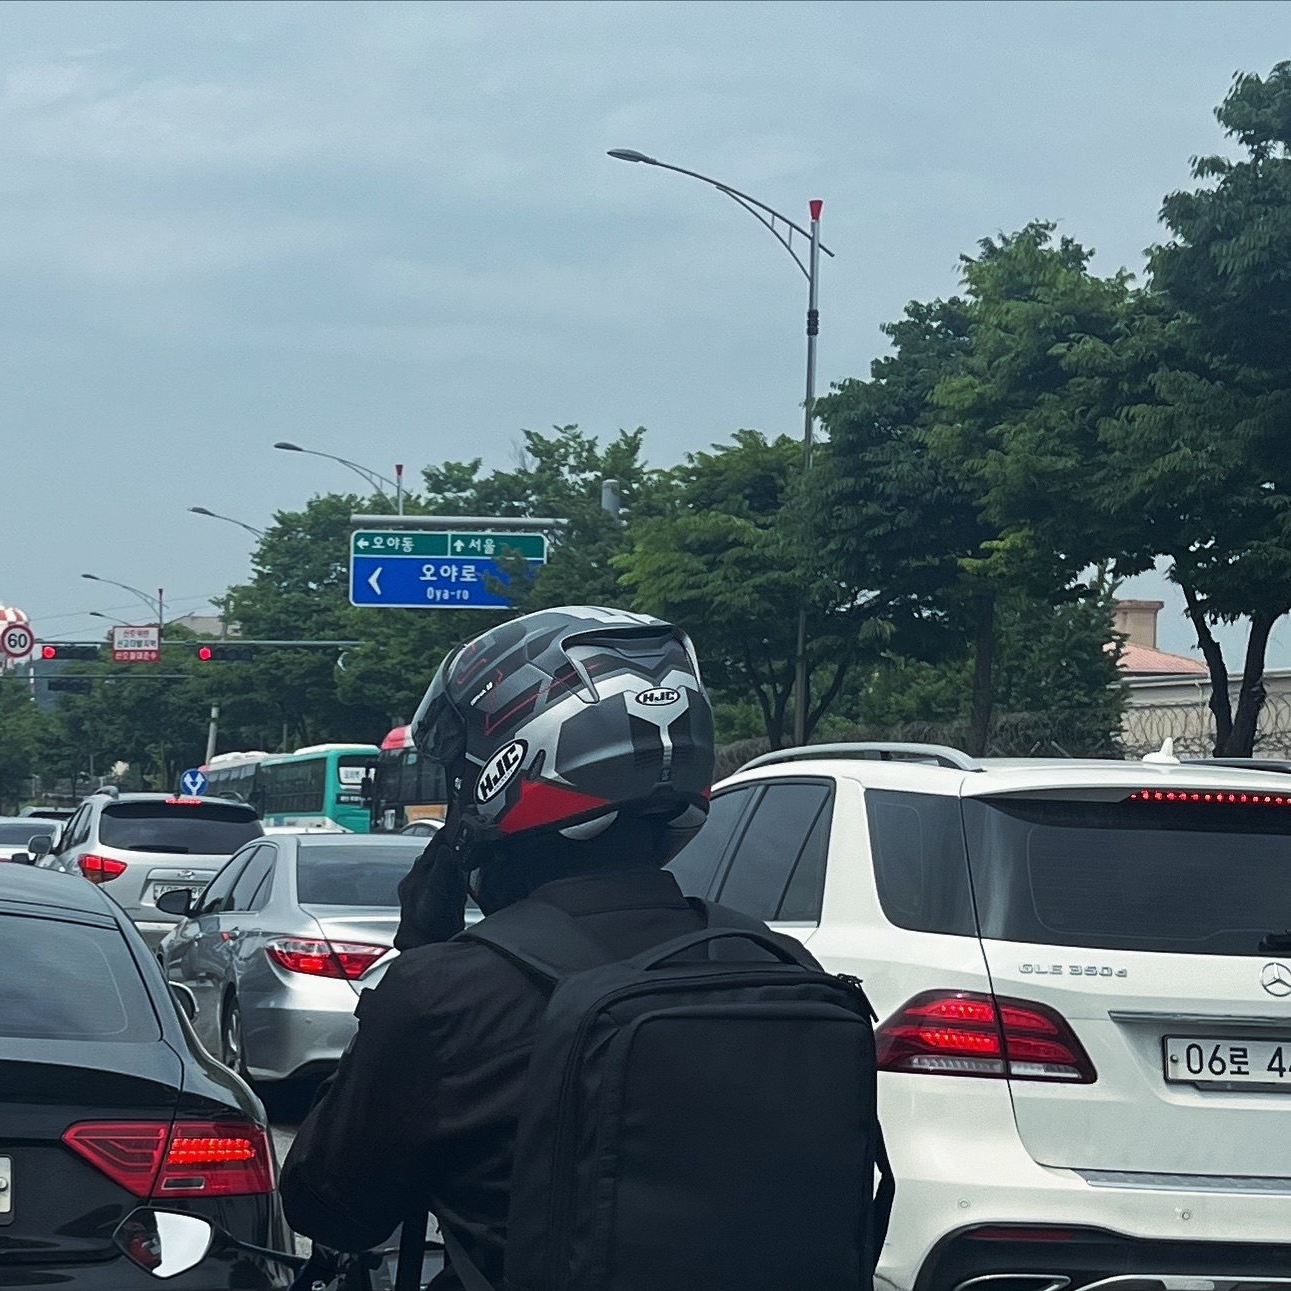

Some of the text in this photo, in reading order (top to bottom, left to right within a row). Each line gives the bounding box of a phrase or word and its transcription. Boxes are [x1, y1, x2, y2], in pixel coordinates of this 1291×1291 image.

[371, 537, 415, 553] 오야동
[468, 537, 496, 555] 서울
[418, 564, 478, 583] 오야로
[426, 586, 470, 601] Oya-ro
[7, 632, 28, 648] 60
[642, 690, 676, 704] HJC
[480, 744, 520, 801] HJC
[1018, 963, 1063, 975] GLE
[1186, 1043, 1250, 1076] 06로
